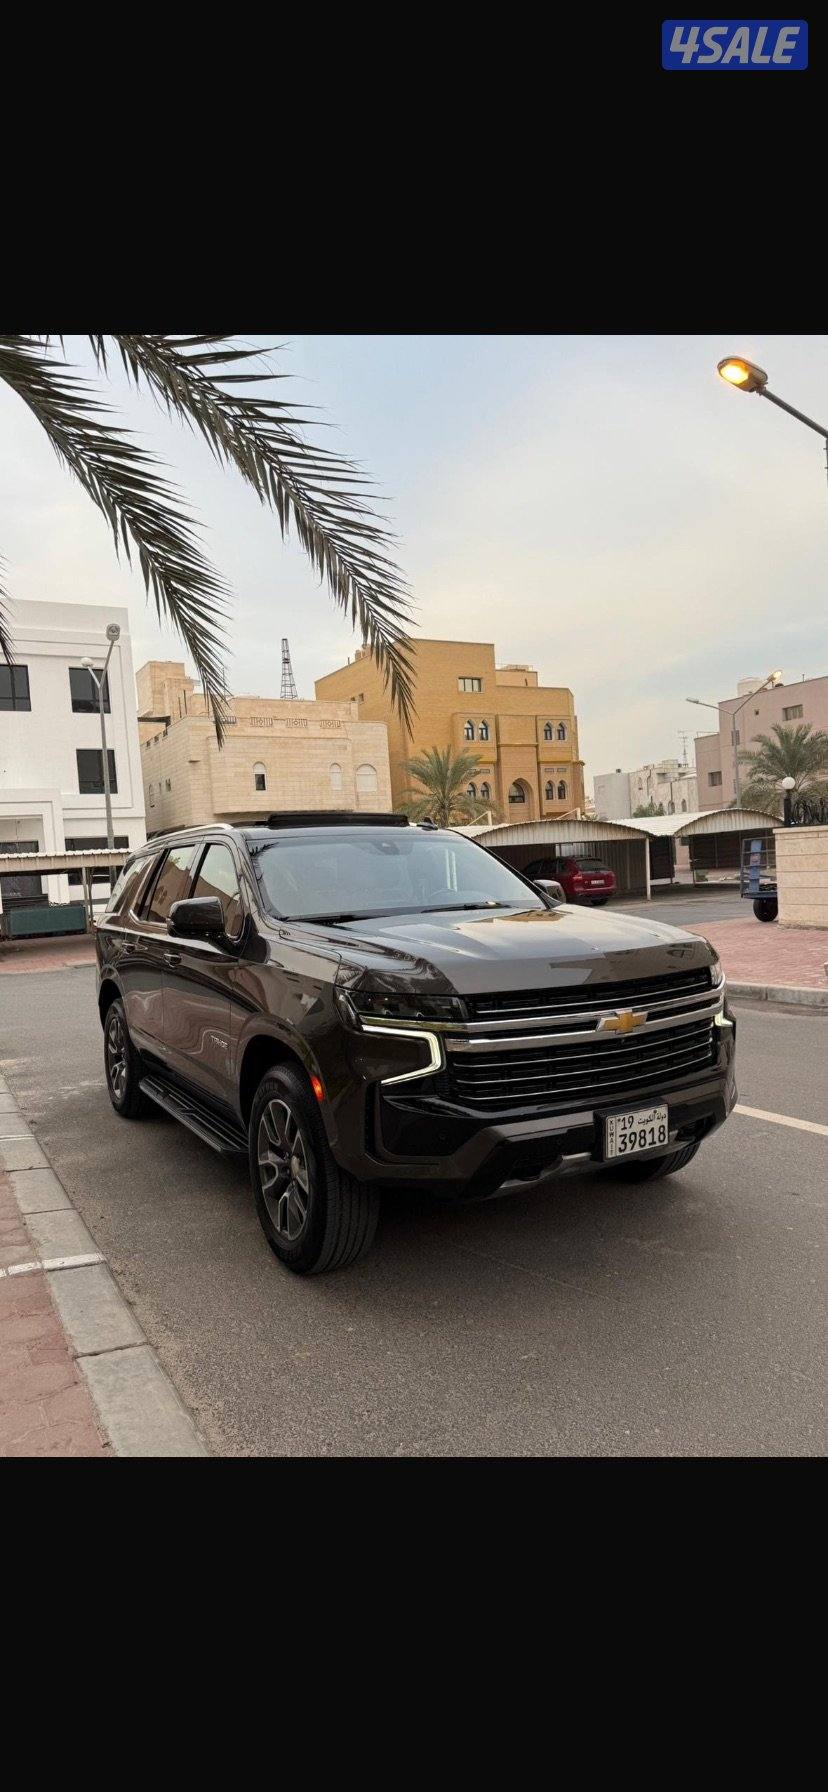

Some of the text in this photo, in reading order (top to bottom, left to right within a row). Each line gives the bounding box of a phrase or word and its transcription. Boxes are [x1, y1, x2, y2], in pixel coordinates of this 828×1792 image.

[621, 1115, 634, 1131] 19
[637, 1113, 656, 1126] الكويت
[618, 1124, 666, 1153] 39818
